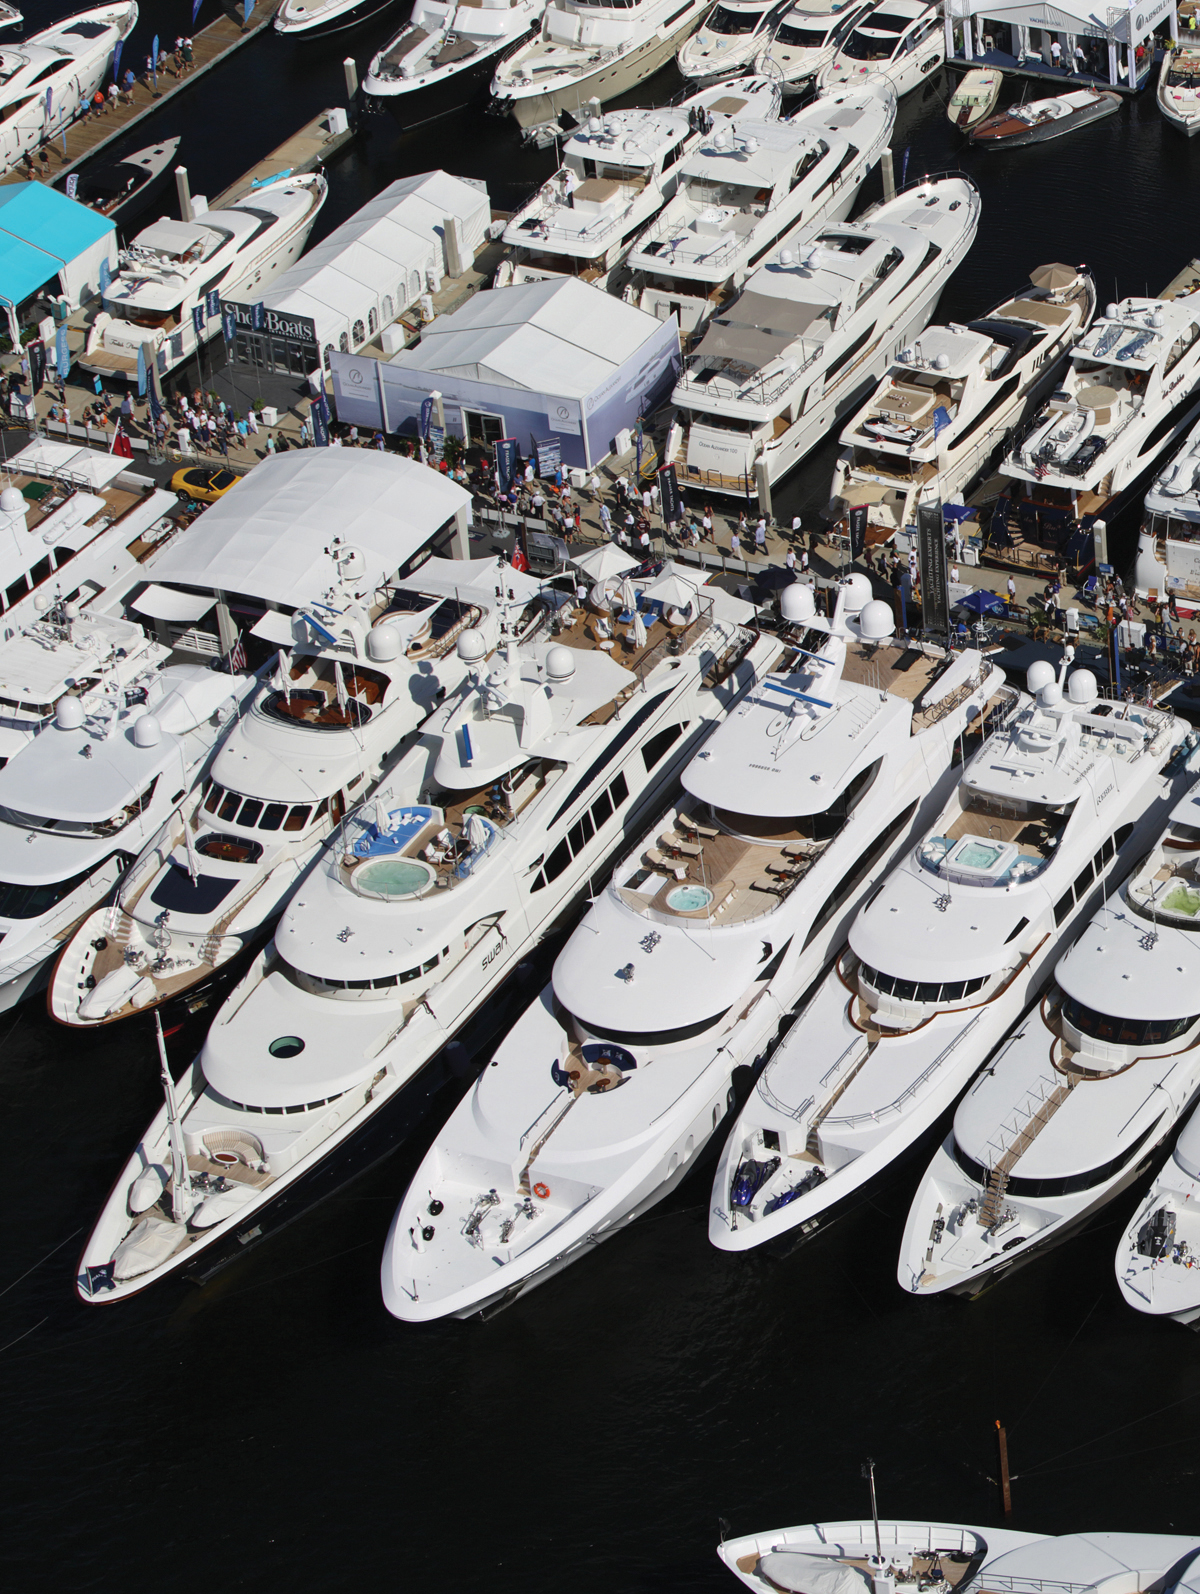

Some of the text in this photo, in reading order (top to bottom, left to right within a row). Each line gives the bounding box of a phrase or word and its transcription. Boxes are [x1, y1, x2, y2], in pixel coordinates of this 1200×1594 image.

[224, 303, 312, 338] ShoBoats
[269, 329, 313, 341] INTERNATIONAL
[1096, 783, 1115, 806] REBEL
